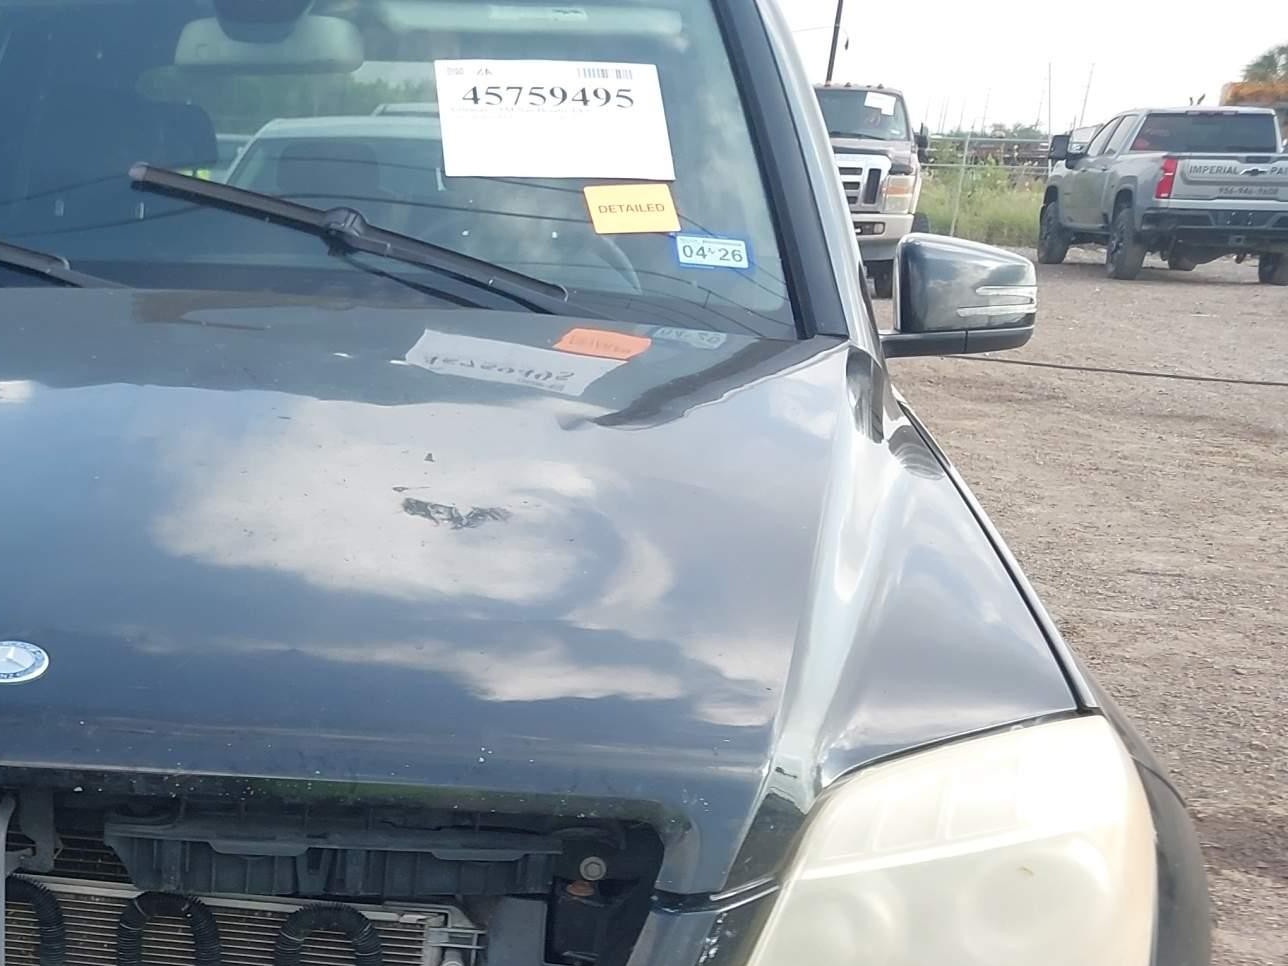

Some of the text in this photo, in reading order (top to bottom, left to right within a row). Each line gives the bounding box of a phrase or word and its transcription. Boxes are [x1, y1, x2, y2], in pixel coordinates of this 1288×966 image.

[461, 85, 635, 109] 45759495
[1189, 165, 1240, 175] IMPERIAL
[597, 203, 666, 214] DETAILED
[682, 244, 744, 263] 04 26
